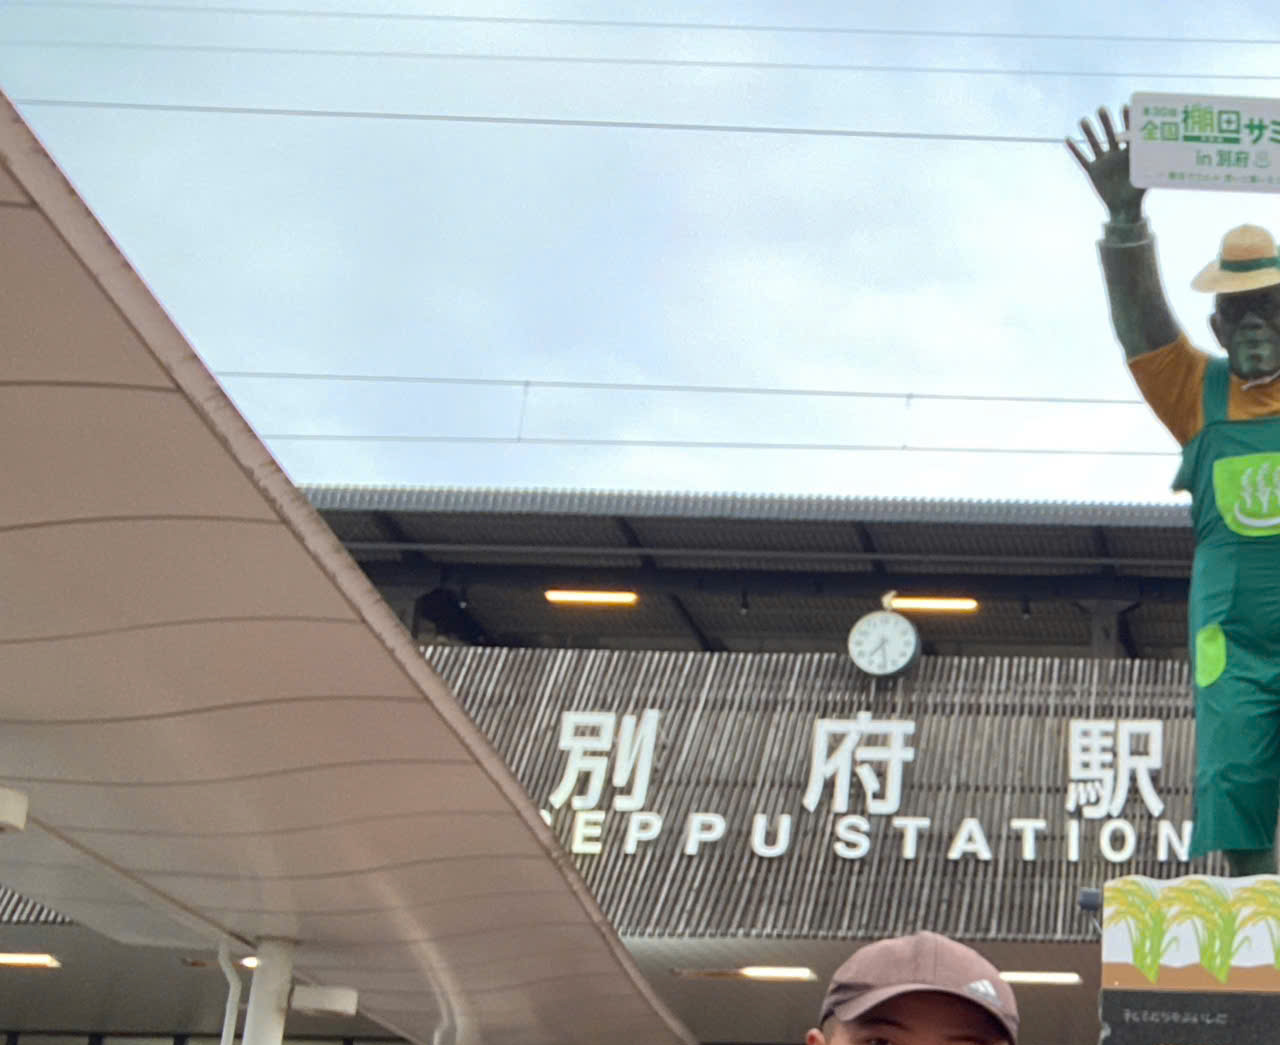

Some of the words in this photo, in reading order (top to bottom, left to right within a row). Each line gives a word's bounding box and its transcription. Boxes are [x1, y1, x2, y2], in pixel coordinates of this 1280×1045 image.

[549, 708, 1164, 820] 別府駅
[540, 809, 792, 858] EPPU
[833, 816, 1193, 862] STATION
